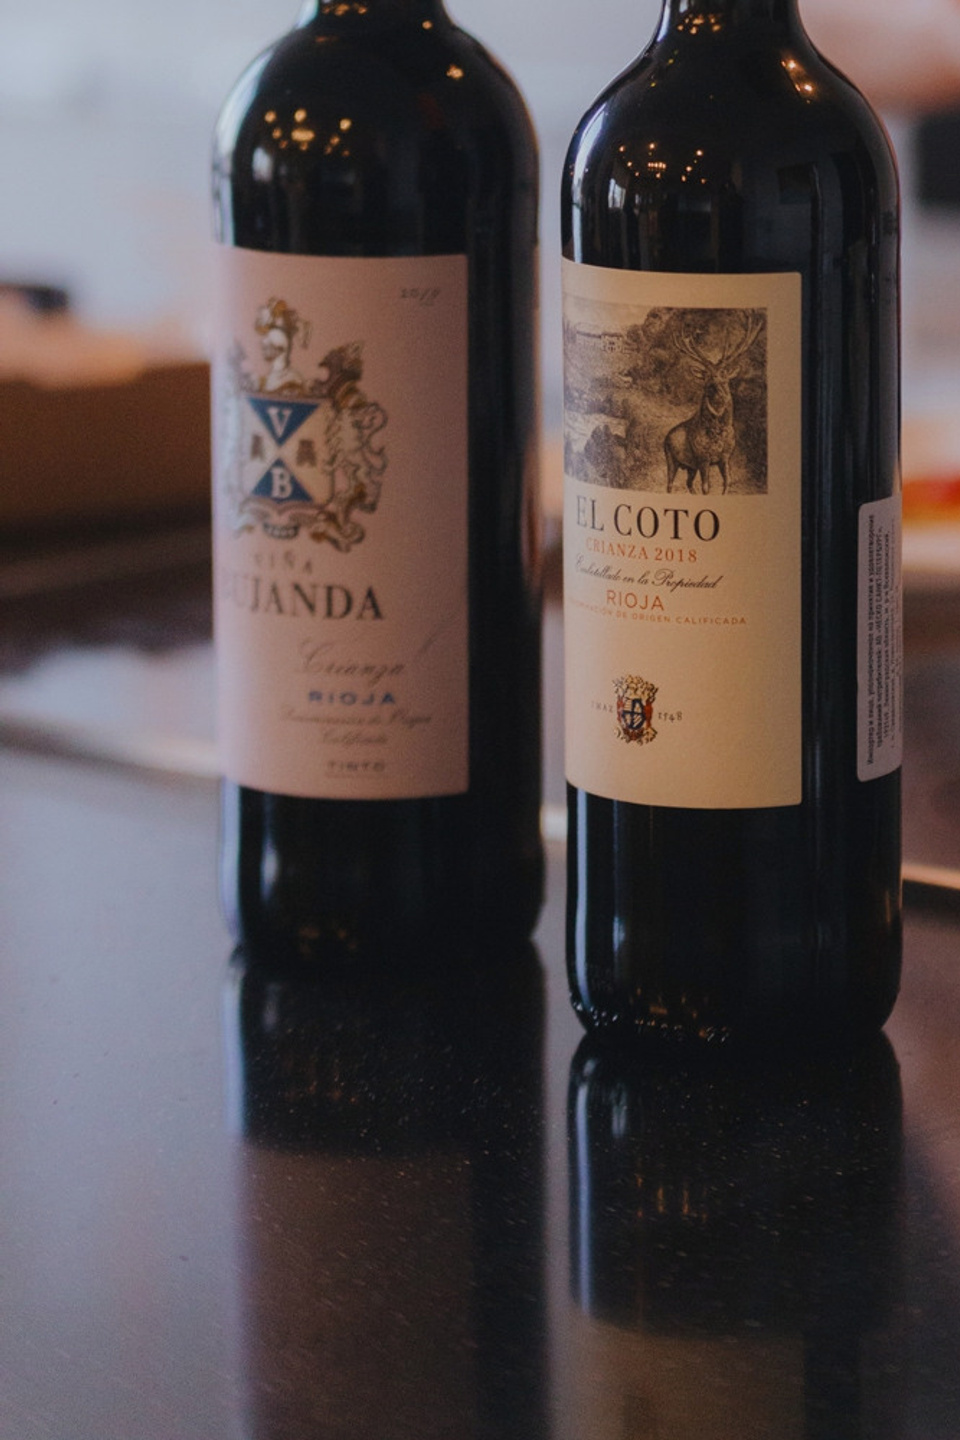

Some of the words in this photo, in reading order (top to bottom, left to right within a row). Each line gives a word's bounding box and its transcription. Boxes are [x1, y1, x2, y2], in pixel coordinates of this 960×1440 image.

[267, 407, 293, 438] V
[270, 466, 293, 498] B
[576, 494, 605, 532] EL
[613, 503, 720, 542] COTO
[585, 536, 649, 560] CRIANZA
[654, 547, 698, 563] 2018
[622, 574, 635, 583] en
[637, 570, 649, 585] la
[651, 568, 724, 593] Propiedad
[223, 571, 383, 620] UJANDA
[606, 589, 665, 611] RIOJA
[616, 610, 628, 619] DE
[632, 612, 671, 624] ORIGEN
[675, 616, 747, 626] CALIFICADA
[307, 690, 396, 706] RIOJA
